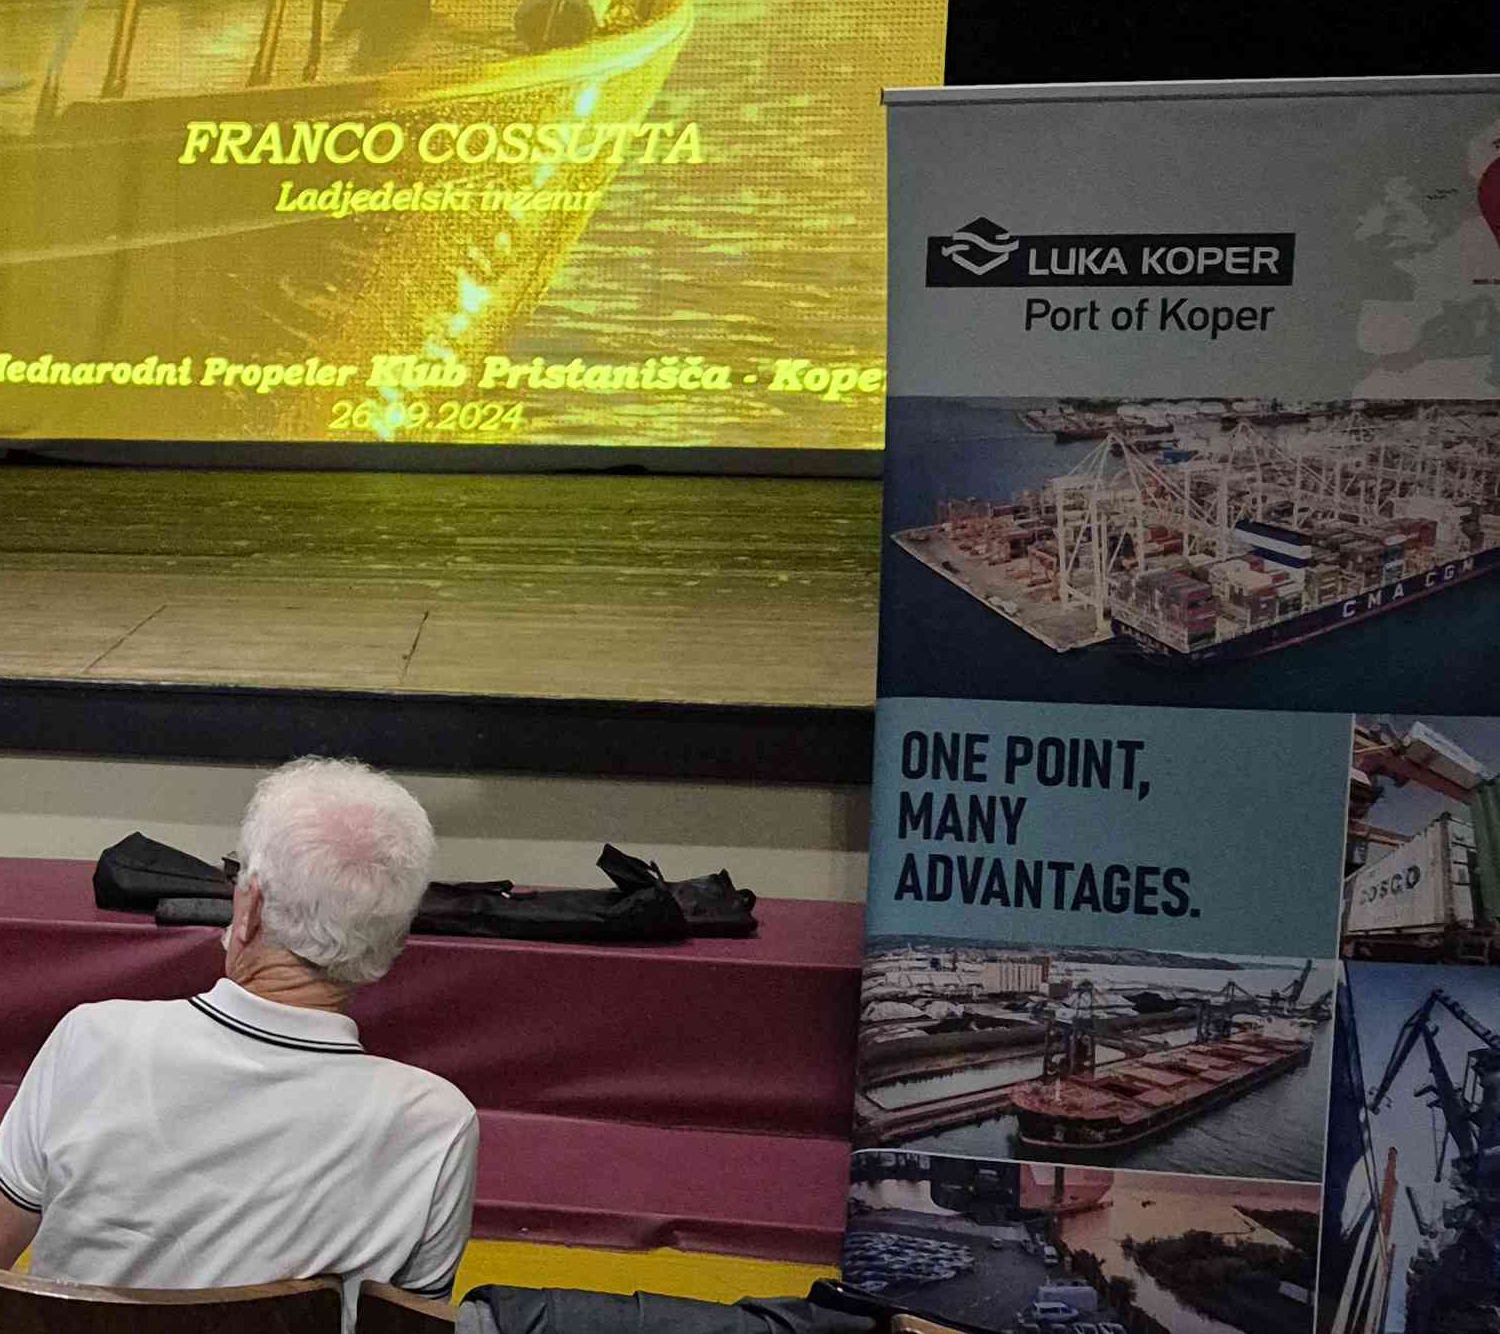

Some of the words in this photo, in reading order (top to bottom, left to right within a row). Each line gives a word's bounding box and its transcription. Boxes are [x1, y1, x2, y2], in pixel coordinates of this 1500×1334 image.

[178, 122, 405, 166] FRANCO
[418, 122, 704, 166] COSSUTTA
[276, 181, 476, 218] Ladjedelski
[1028, 247, 1128, 277] LUKA
[1141, 246, 1280, 275] KOPER
[1025, 298, 1100, 331] Port
[1111, 298, 1149, 330] of
[1160, 298, 1275, 339] Koper
[200, 357, 357, 393] Propeler
[366, 355, 468, 388] Klub
[478, 356, 732, 392] Pristanišča
[329, 401, 526, 431] 2609.2024
[902, 731, 989, 783] ONE
[1005, 735, 1150, 801] POINT,
[898, 791, 1026, 845] MANY
[894, 853, 1201, 918] ADVANTAGES.
